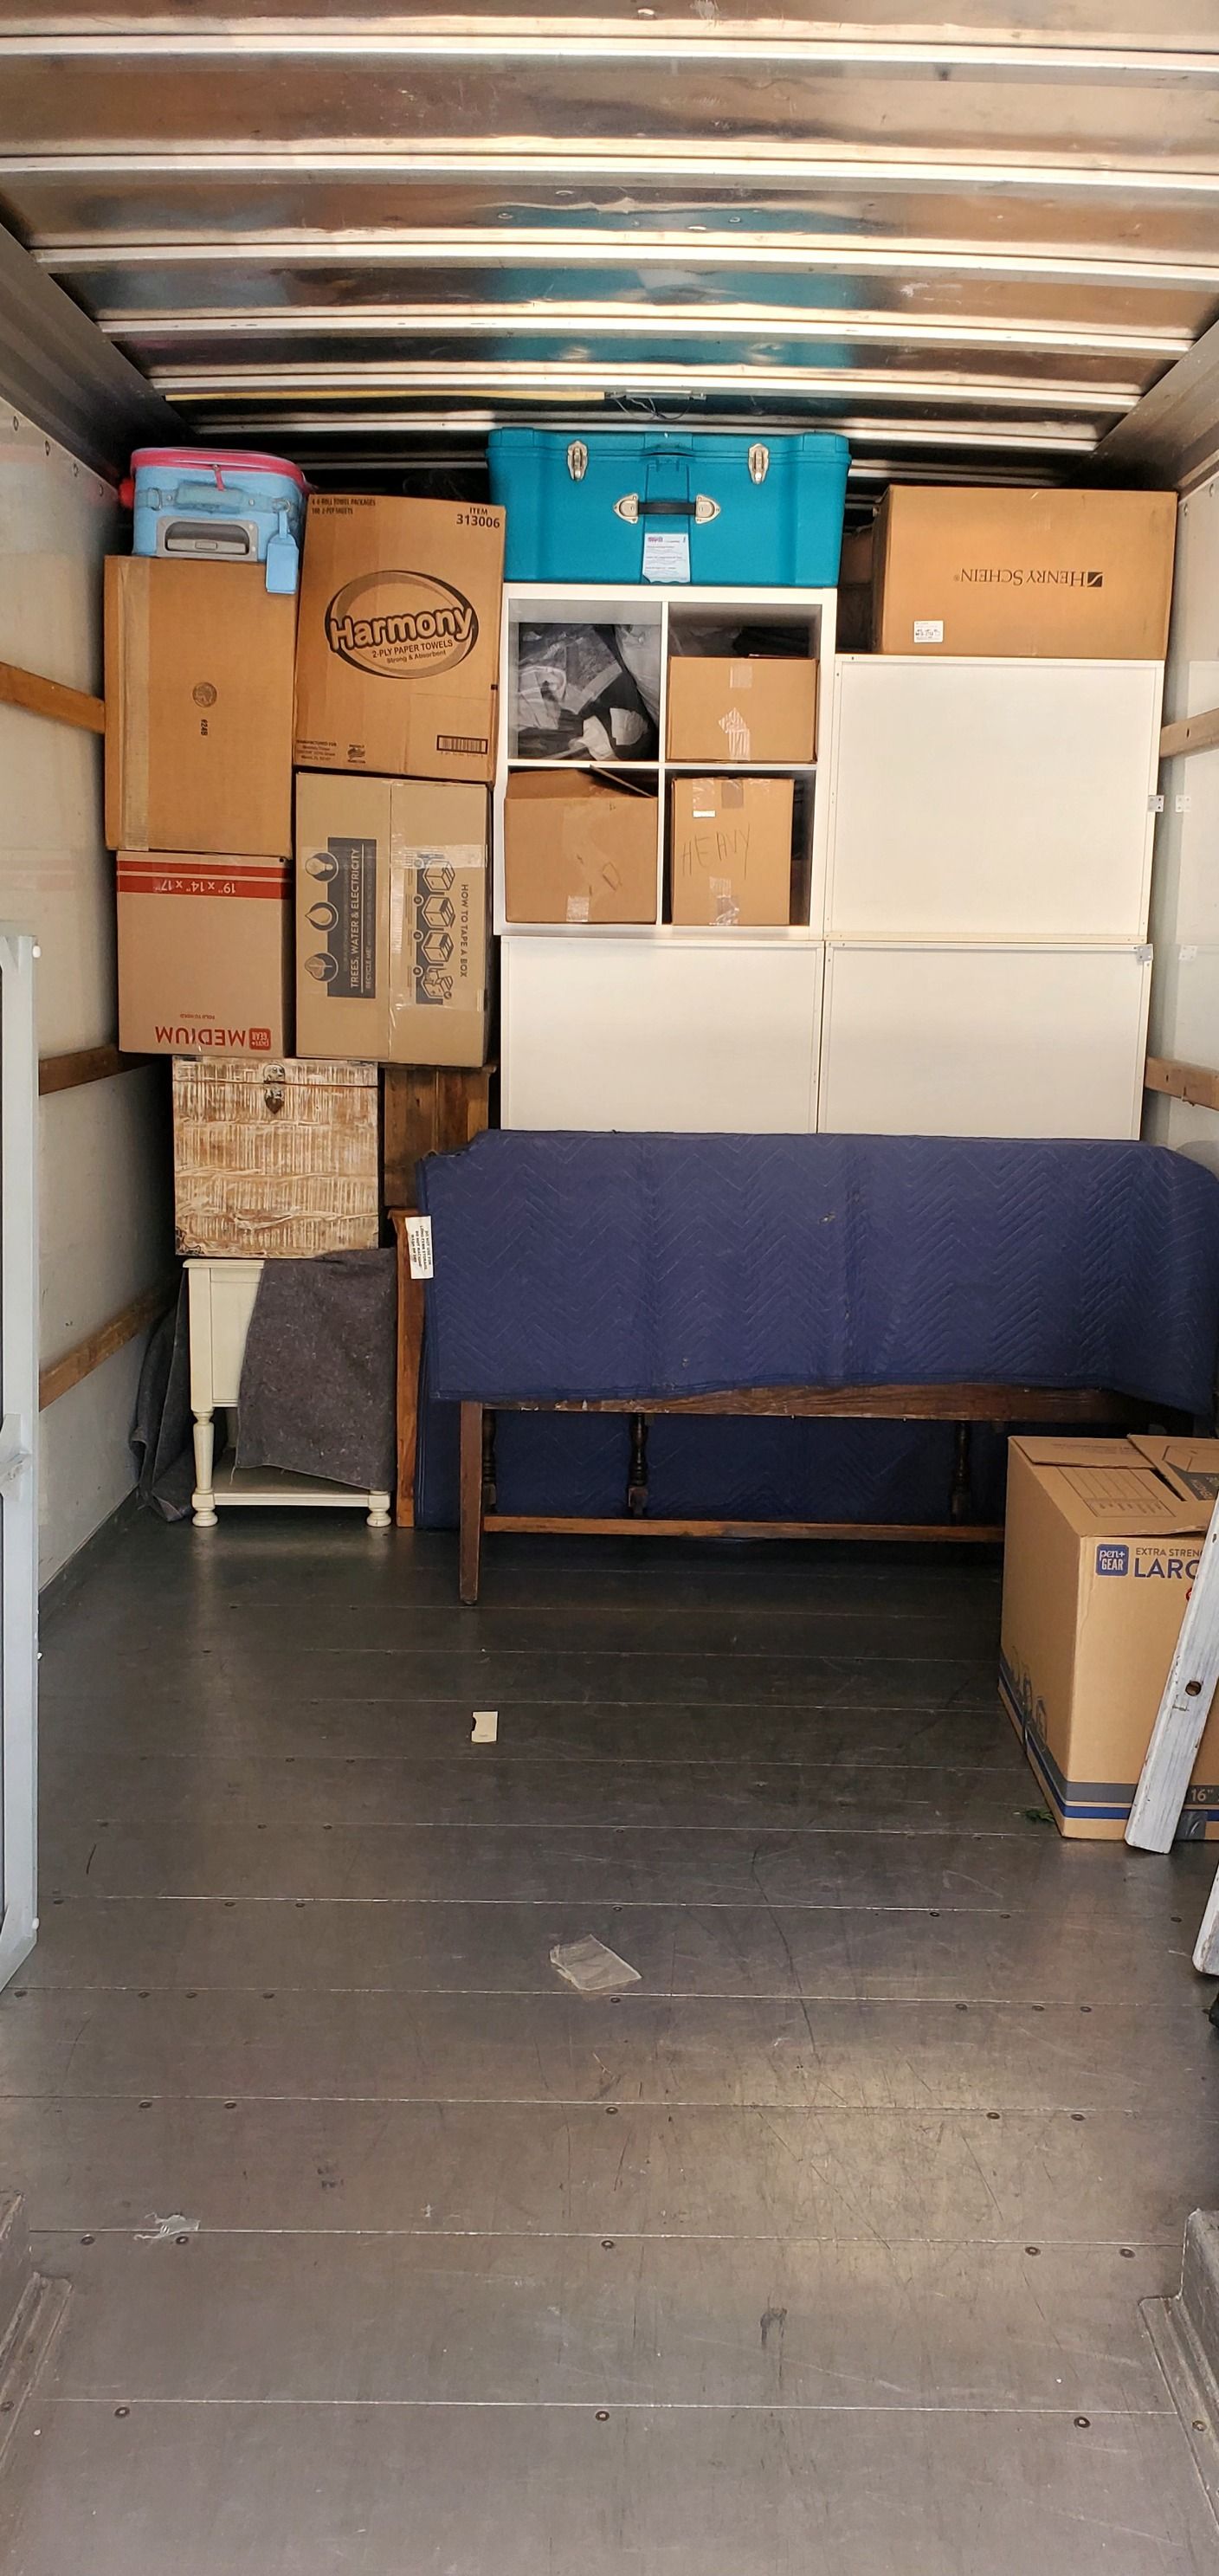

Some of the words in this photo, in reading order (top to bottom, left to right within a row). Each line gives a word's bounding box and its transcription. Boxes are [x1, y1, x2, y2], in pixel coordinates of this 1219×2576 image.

[469, 507, 488, 515] ITEM
[456, 513, 500, 528] 313006
[1025, 570, 1085, 587] HENRY
[330, 606, 474, 652] Harmony
[372, 648, 393, 658] 2-PLY
[394, 644, 420, 655] PAPER
[421, 639, 453, 652] TOWELS
[387, 655, 408, 664] Strong
[414, 649, 446, 660] Absorbent
[680, 823, 751, 881] HEAVY
[175, 880, 183, 888] x
[351, 848, 359, 909] ELECTRICITY
[186, 881, 205, 892] 14"
[218, 882, 235, 894] 19"
[461, 910, 468, 923] TO
[350, 920, 359, 954] WATER
[350, 956, 360, 988] TREES,
[155, 1026, 246, 1047] MEDIUM
[252, 1031, 269, 1040] GEAR
[1100, 1549, 1125, 1561] pen+
[1135, 1547, 1166, 1556] EXTRA
[1169, 1548, 1203, 1557] STREN
[1101, 1559, 1124, 1571] GEAR
[1191, 1788, 1214, 1801] 16"
